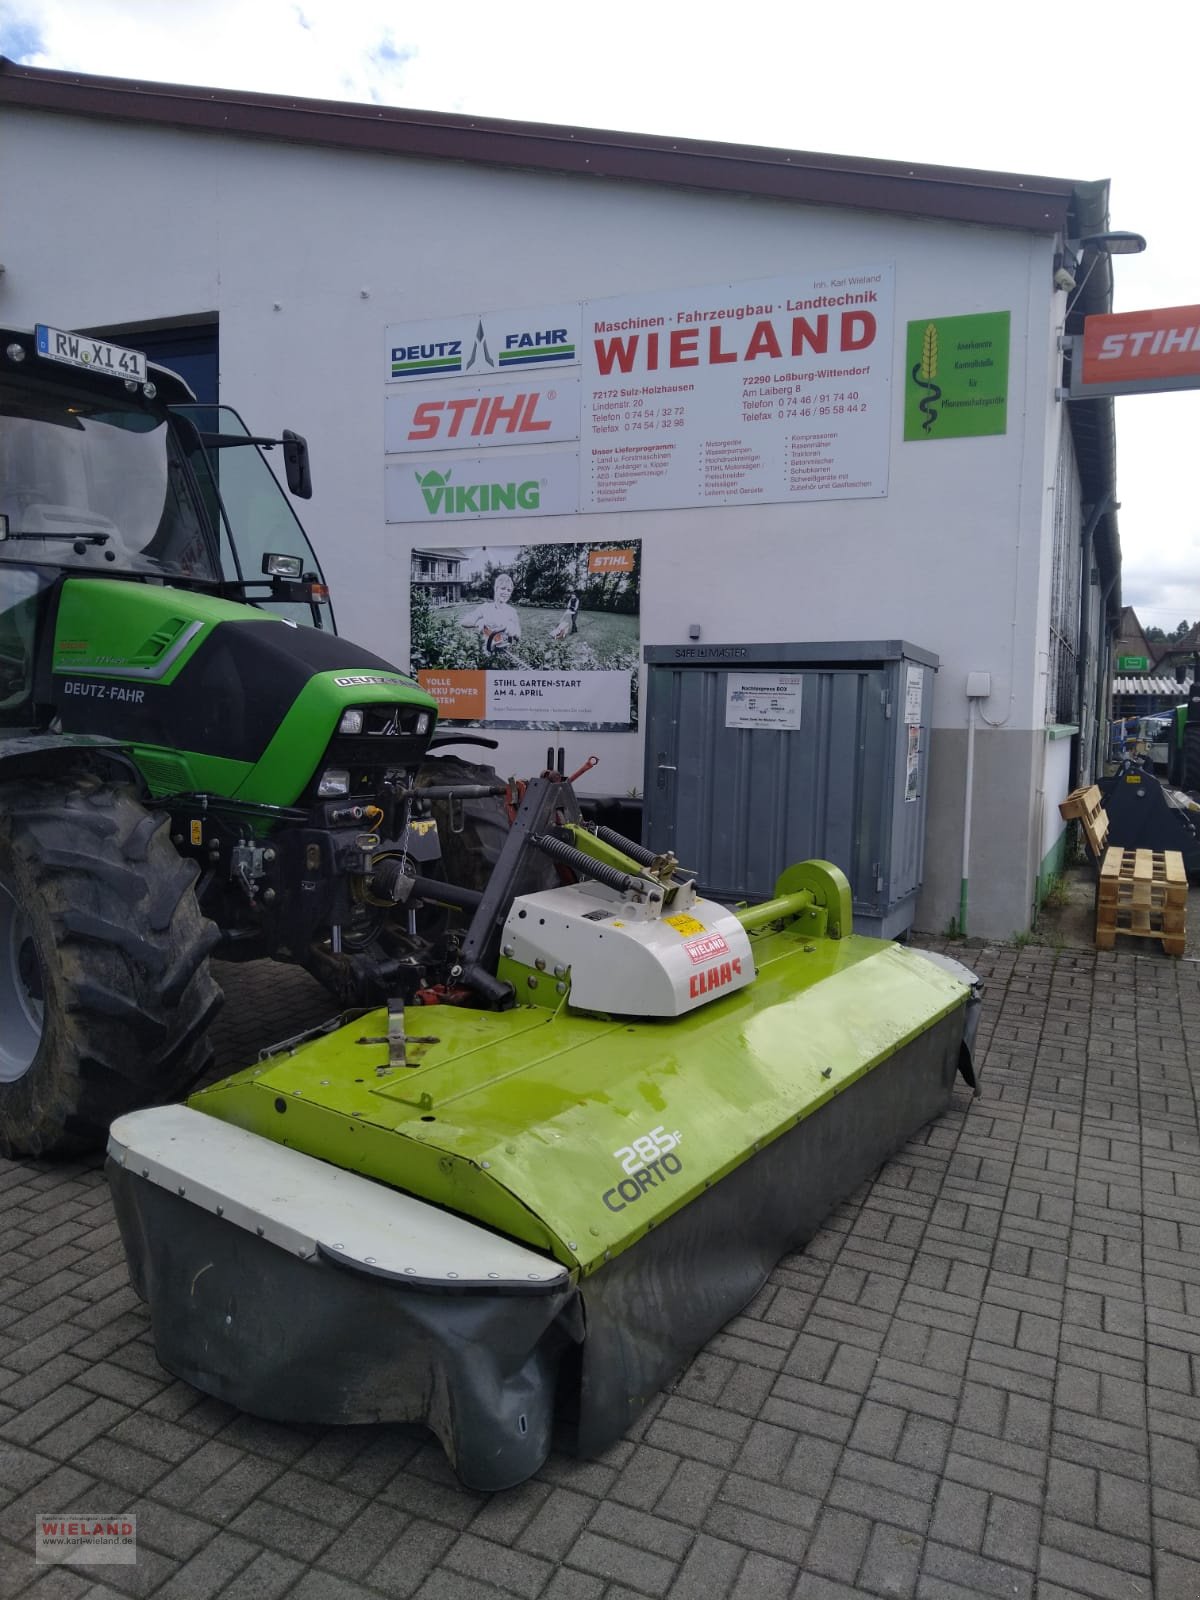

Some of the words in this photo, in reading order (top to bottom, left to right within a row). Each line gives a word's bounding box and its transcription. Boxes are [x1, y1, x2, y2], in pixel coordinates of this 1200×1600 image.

[813, 280, 829, 290] Inh.
[831, 277, 848, 288] Karl
[848, 274, 882, 287] Wieland
[594, 314, 665, 334] Maschinen
[677, 302, 773, 324] Fahrzeugbau
[786, 290, 878, 312] Landtechnik
[391, 341, 462, 362] DEUTZ
[505, 328, 568, 349] FAHR
[594, 309, 877, 376] WIELAND
[55, 333, 79, 359] RW
[92, 343, 115, 369] XI
[118, 352, 140, 375] 41
[743, 375, 771, 386] 72290
[773, 366, 871, 383] Loßburg-Wittendorf
[593, 390, 618, 399] 72172
[620, 384, 695, 397] Sulz-Holzhausen
[742, 389, 757, 398] Am
[759, 386, 793, 396] Laiberg
[795, 384, 801, 393] 8
[592, 401, 631, 411] Lindenstr.
[633, 399, 644, 408] 20
[743, 400, 774, 409] Telefon
[778, 398, 784, 407] 0
[787, 397, 797, 406] 74
[800, 395, 812, 404] 46
[819, 394, 830, 403] 91
[833, 393, 844, 401] 74
[847, 391, 859, 400] 40
[407, 393, 552, 440] STIHL
[592, 413, 620, 422] Telefon
[624, 411, 630, 419] 0
[632, 411, 642, 419] 74
[644, 409, 654, 418] 54
[662, 408, 672, 416] 32
[674, 406, 685, 415] 72
[742, 412, 772, 422] Telefax
[778, 410, 784, 419] 0
[787, 409, 797, 418] 74
[819, 406, 830, 415] 95
[833, 405, 844, 414] 58
[847, 404, 858, 413] 44
[860, 403, 867, 412] 2
[592, 425, 619, 433] Telefax
[624, 423, 630, 431] 0
[632, 422, 642, 430] 74
[644, 421, 654, 430] 54
[661, 420, 672, 428] 32
[791, 432, 838, 442] Kompressoren
[615, 443, 676, 454] Lieferprogramm:
[790, 466, 831, 475] Schubkarren
[421, 481, 540, 515] VIKING
[593, 556, 629, 567] STIHL
[674, 648, 696, 658] SAFE
[709, 648, 747, 657] MASTER
[426, 678, 452, 686] VOLLE
[519, 680, 582, 688] GARTEN-START
[64, 681, 145, 704] DEUTZ-FAHR
[450, 688, 479, 696] POWER
[508, 689, 517, 697] 4.
[519, 689, 544, 697] APRIL
[688, 938, 726, 958] WIELAND
[602, 1152, 683, 1213] CORTO
